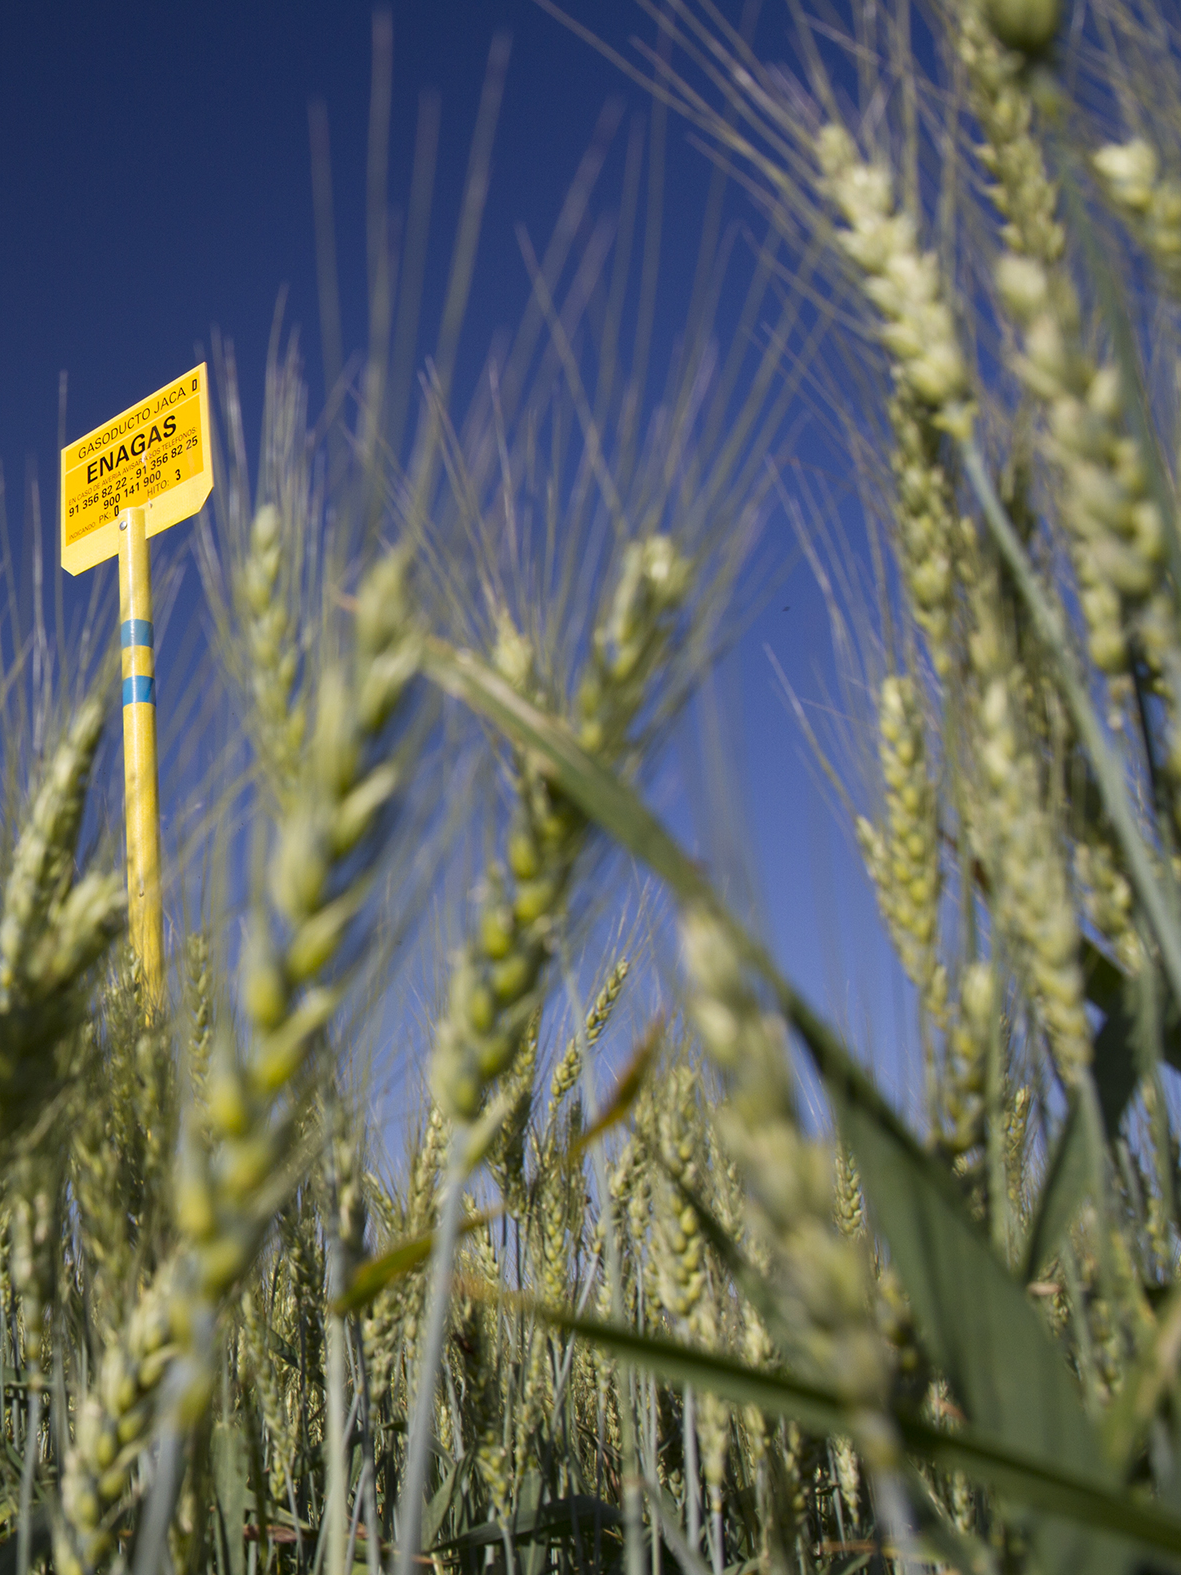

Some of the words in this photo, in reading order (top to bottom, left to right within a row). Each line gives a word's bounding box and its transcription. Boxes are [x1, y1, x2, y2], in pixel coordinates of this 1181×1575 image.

[78, 407, 151, 459] GASODUCTO
[153, 387, 186, 414] JACA
[86, 414, 177, 485] ENAGAS
[69, 504, 79, 518] 91
[82, 492, 99, 510] 356
[101, 484, 113, 499] 82
[115, 476, 127, 491] 22
[135, 465, 147, 479] 91
[150, 452, 169, 471] 356
[170, 444, 184, 459] 82
[185, 435, 199, 451] 25
[69, 496, 77, 506] EN
[77, 487, 93, 501] CASO
[93, 482, 101, 492] DE
[98, 511, 112, 524] PK:
[146, 479, 170, 498] HITO:
[174, 468, 182, 481] 3
[103, 493, 121, 510] 900
[123, 481, 140, 498] 141
[143, 469, 162, 488] 900
